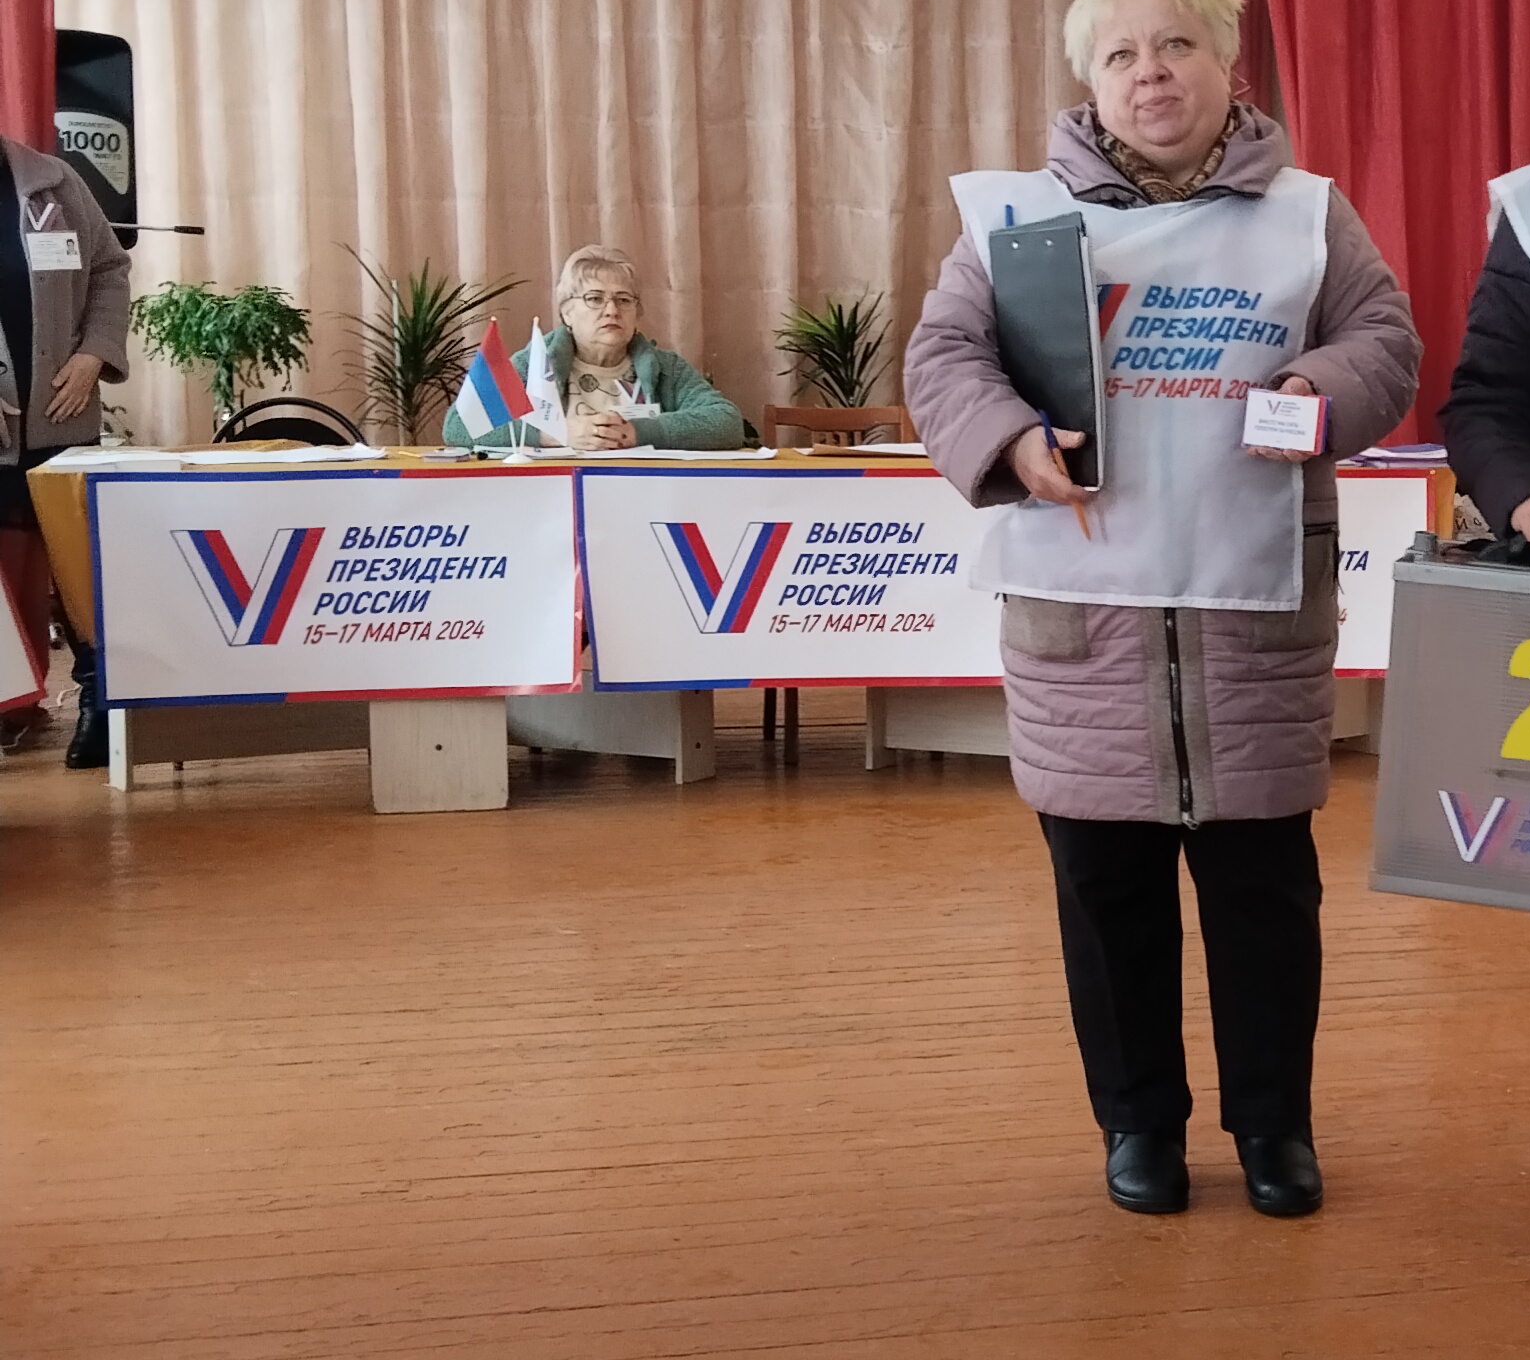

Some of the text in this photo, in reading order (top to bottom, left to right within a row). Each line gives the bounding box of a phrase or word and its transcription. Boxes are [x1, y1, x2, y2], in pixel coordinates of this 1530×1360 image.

[62, 130, 120, 152] 1000
[1141, 285, 1262, 311] ВЫБОРЫ
[1125, 316, 1289, 348] ПРЕЗИДЕНТА
[1110, 346, 1224, 371] РОССИИ
[1154, 378, 1222, 400] МАРТА
[339, 525, 470, 550] ВЫБОРЫ
[805, 522, 925, 544] ВЫБОРЫ
[326, 557, 507, 584] ПРЕЗИДЕНТА
[791, 553, 959, 578] ПРЕЗИДЕНТА
[313, 590, 431, 615] РОССИИ
[778, 584, 888, 606] РОССИИ
[362, 621, 432, 643] МАРТА
[435, 619, 485, 641] 2024
[822, 614, 887, 632] МАРТА
[889, 613, 936, 632] 2024
